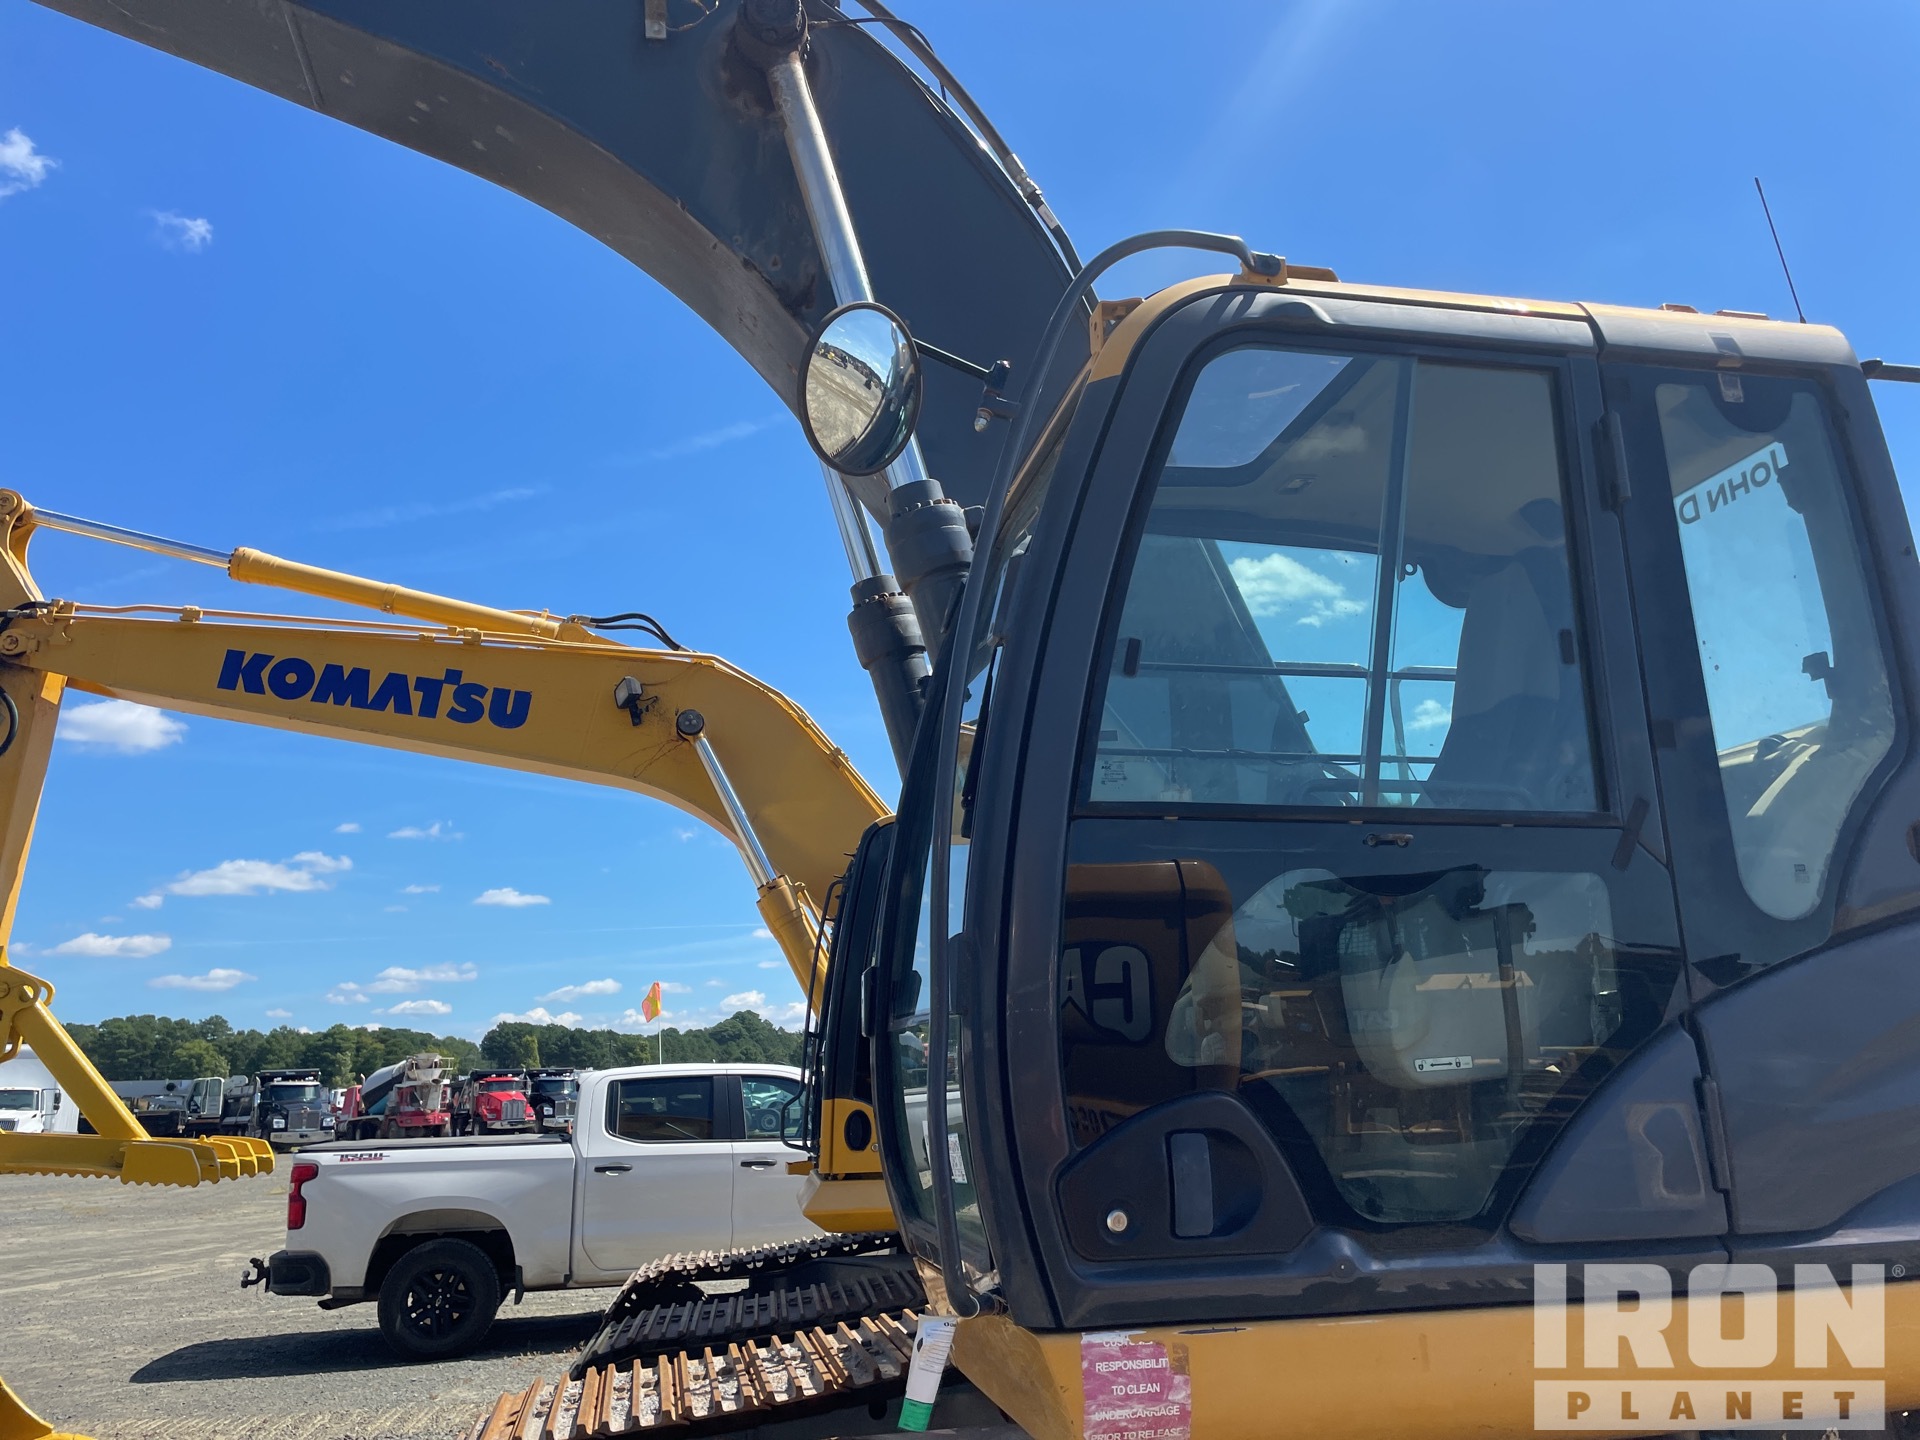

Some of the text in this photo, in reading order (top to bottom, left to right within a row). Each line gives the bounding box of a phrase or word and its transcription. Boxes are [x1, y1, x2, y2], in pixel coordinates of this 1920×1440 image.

[216, 648, 533, 729] KOMATSU
[1112, 1382, 1161, 1396] TO CLEAN
